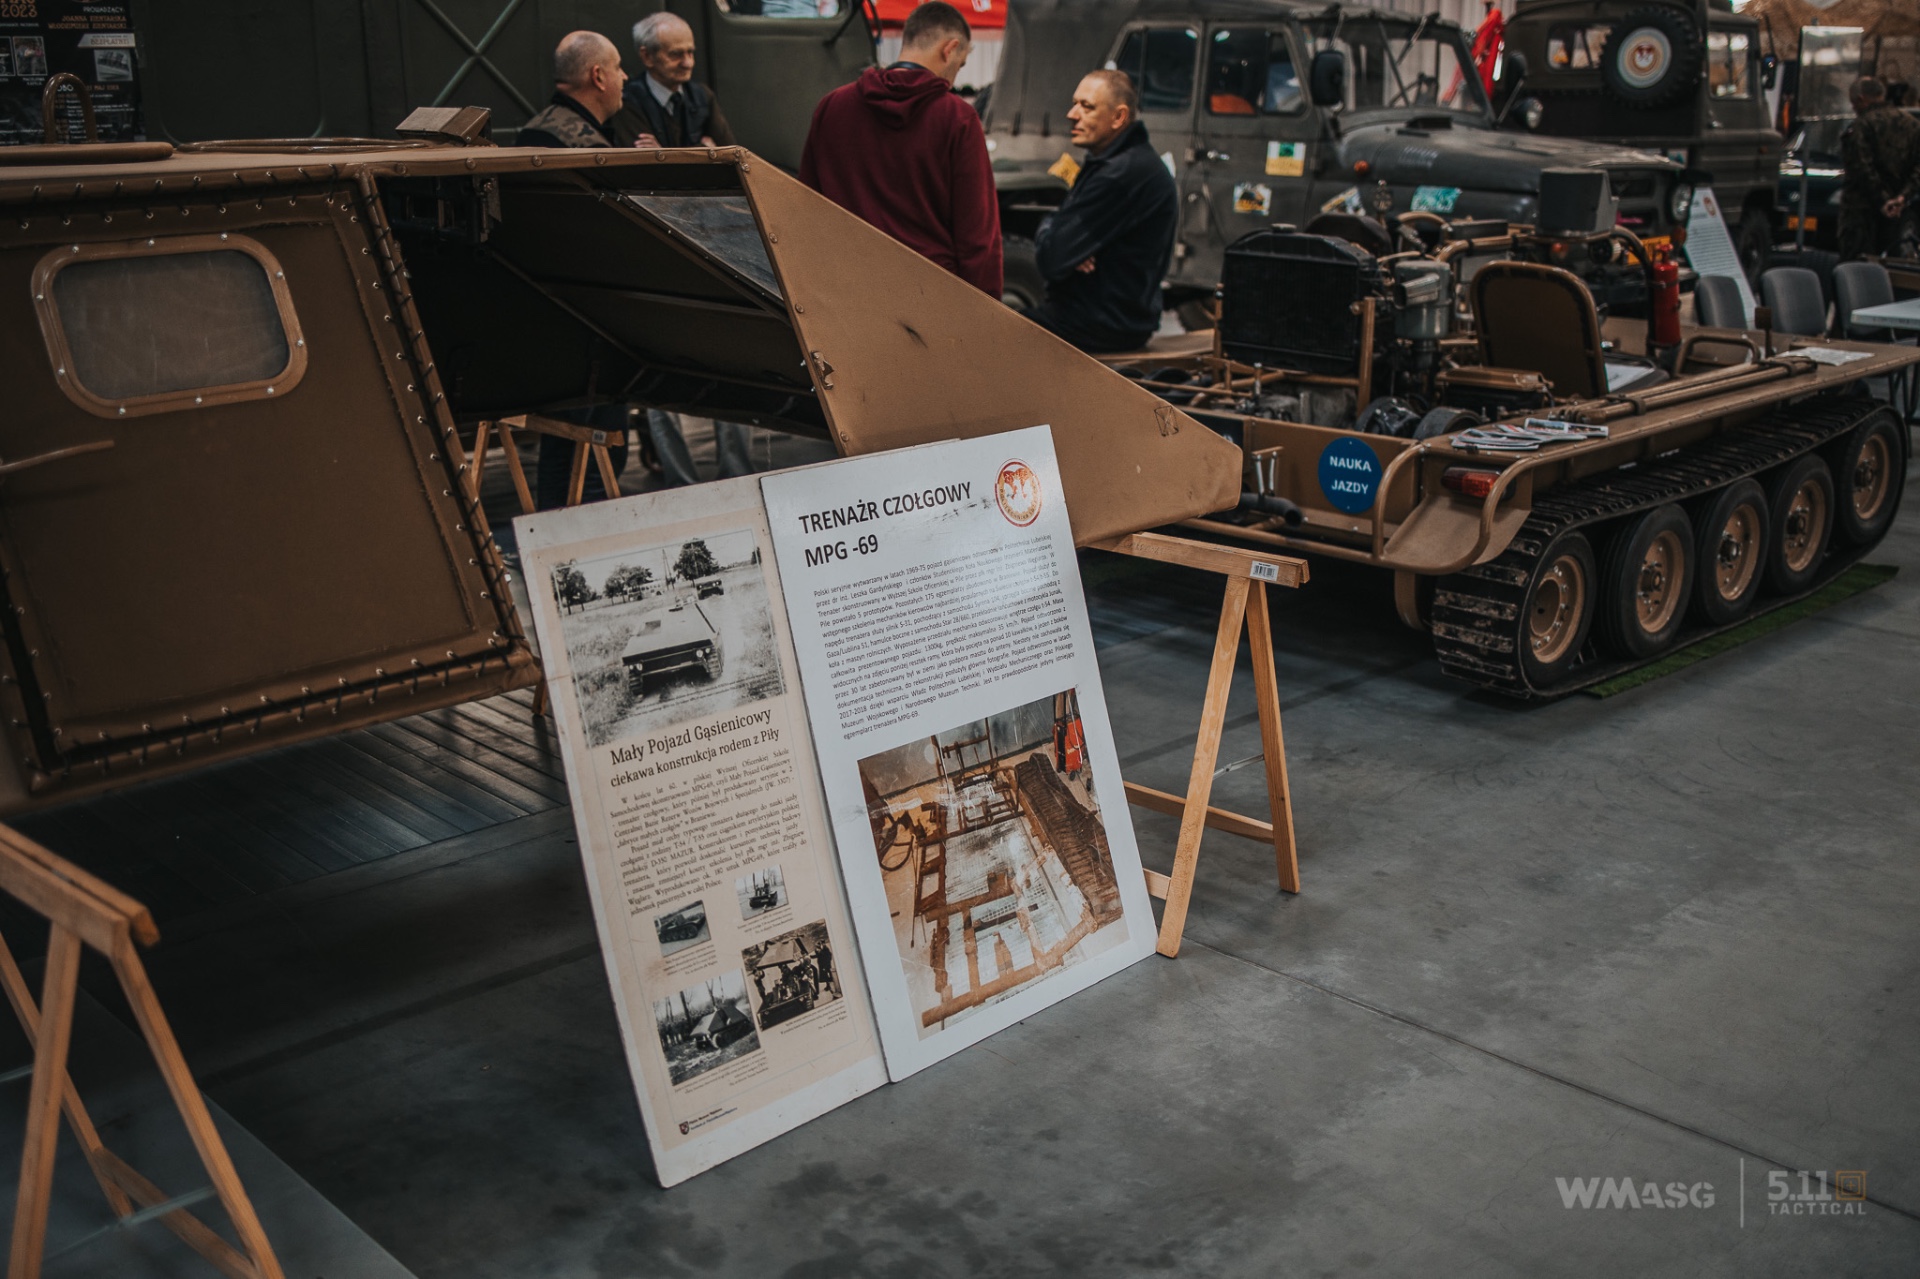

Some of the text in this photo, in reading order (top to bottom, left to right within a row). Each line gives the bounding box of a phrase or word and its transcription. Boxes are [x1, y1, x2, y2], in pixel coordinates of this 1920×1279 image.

[1, 5, 38, 18] 2023
[1329, 455, 1372, 473] NAUKA
[1331, 479, 1369, 495] JAZDY
[799, 499, 880, 534] TRENAŻR
[883, 481, 971, 516] CZOŁGOWY
[804, 534, 879, 567] MPG -69
[610, 709, 772, 766] Mały Pojazd Gąsienicowy
[610, 728, 780, 788] ciekawa konstrukcja rodem z Piły
